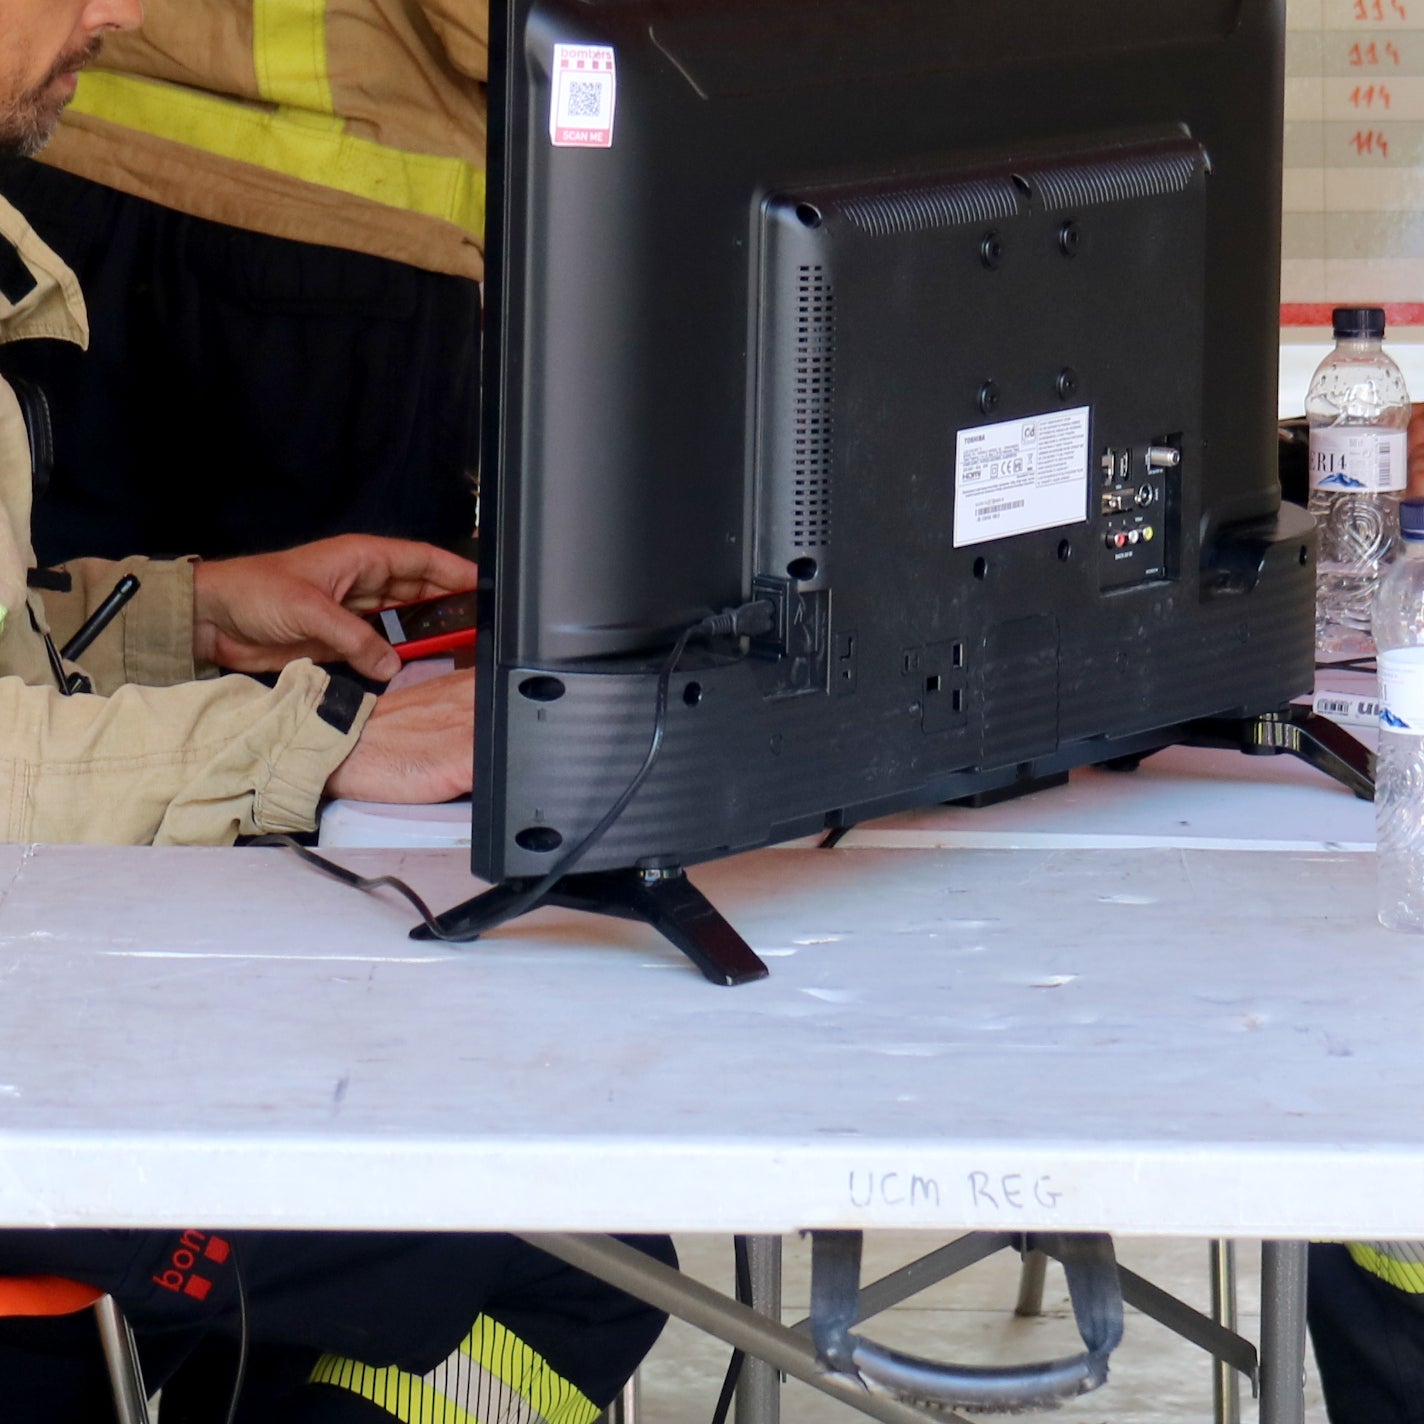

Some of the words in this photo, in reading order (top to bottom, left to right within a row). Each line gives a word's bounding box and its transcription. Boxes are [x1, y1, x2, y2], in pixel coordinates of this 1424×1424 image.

[562, 130, 588, 142] SCAN
[589, 131, 603, 142] ME
[849, 1171, 940, 1208] UCM
[967, 1170, 1063, 1209] REG
